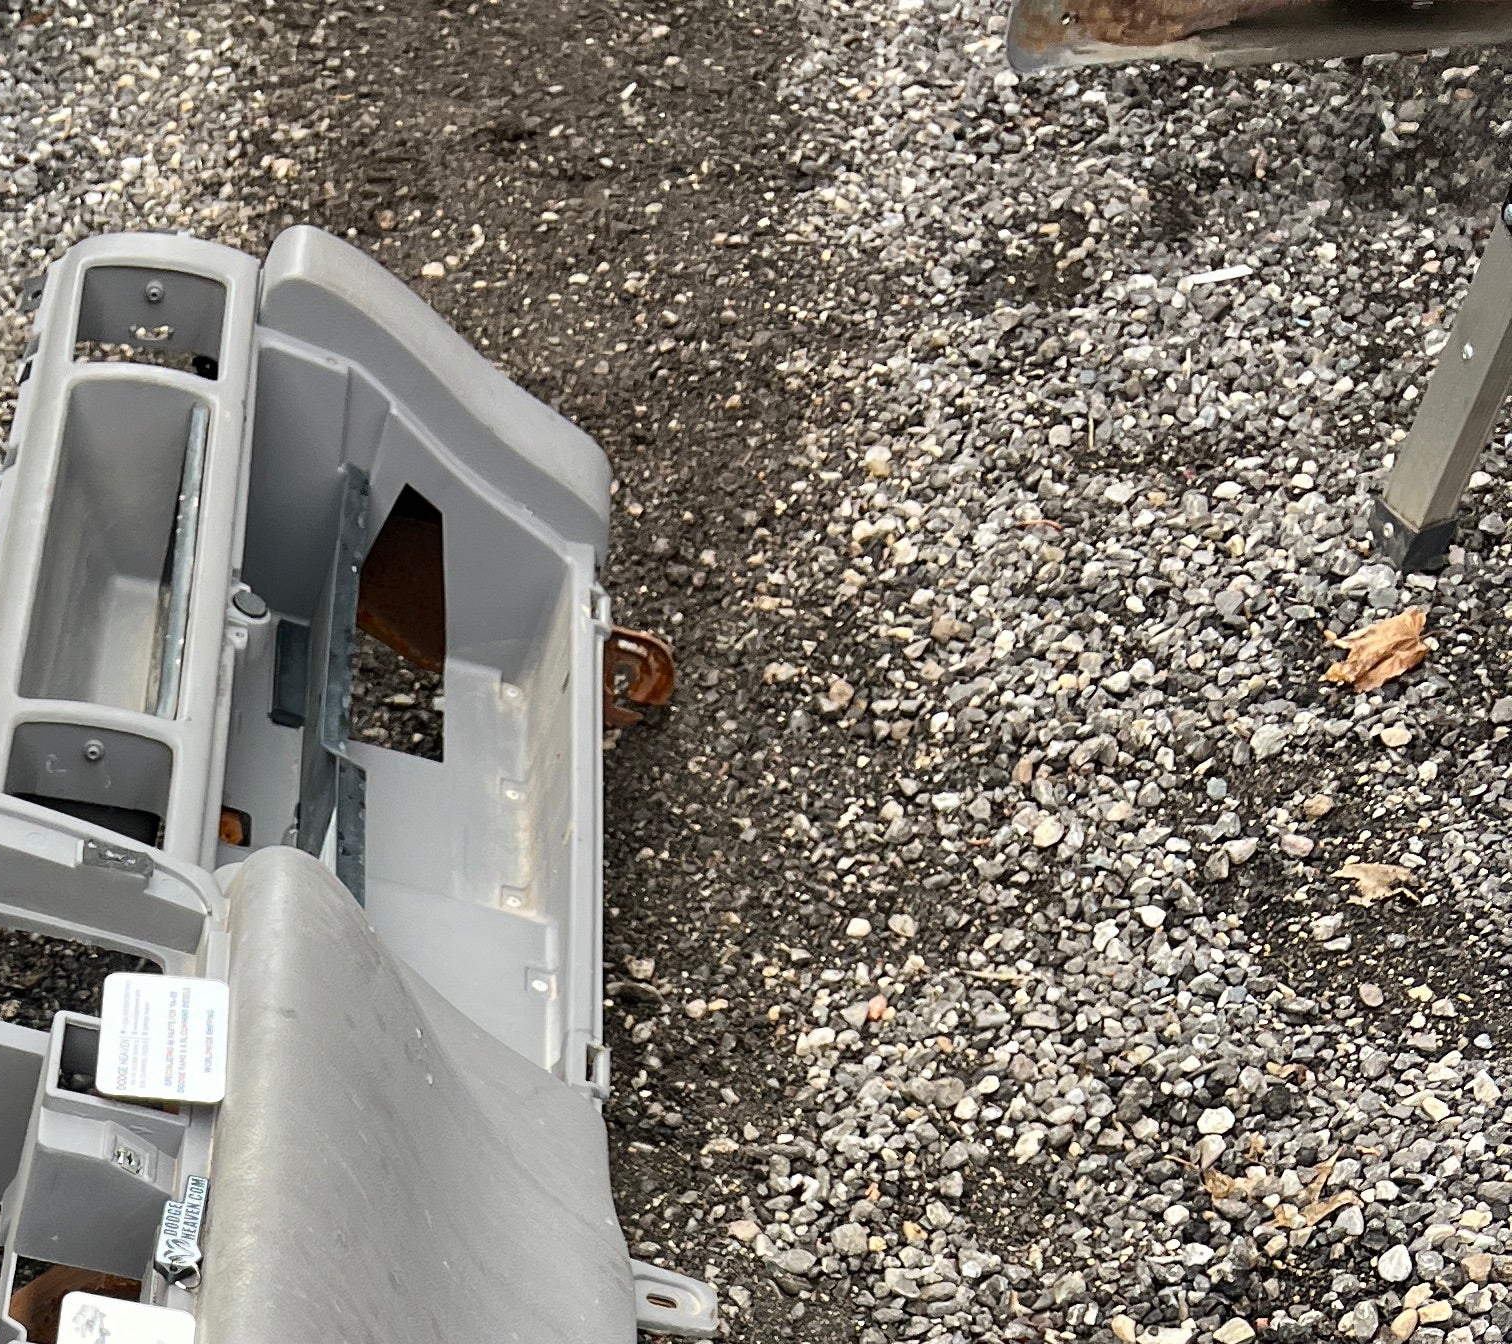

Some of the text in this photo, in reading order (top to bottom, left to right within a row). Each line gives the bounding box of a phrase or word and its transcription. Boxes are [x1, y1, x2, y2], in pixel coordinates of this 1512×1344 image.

[120, 1039, 129, 1065] HEAVEN
[116, 1066, 128, 1091] DODGE
[163, 1202, 183, 1236] DODGE
[180, 1178, 206, 1241] HEAVEN.COM
